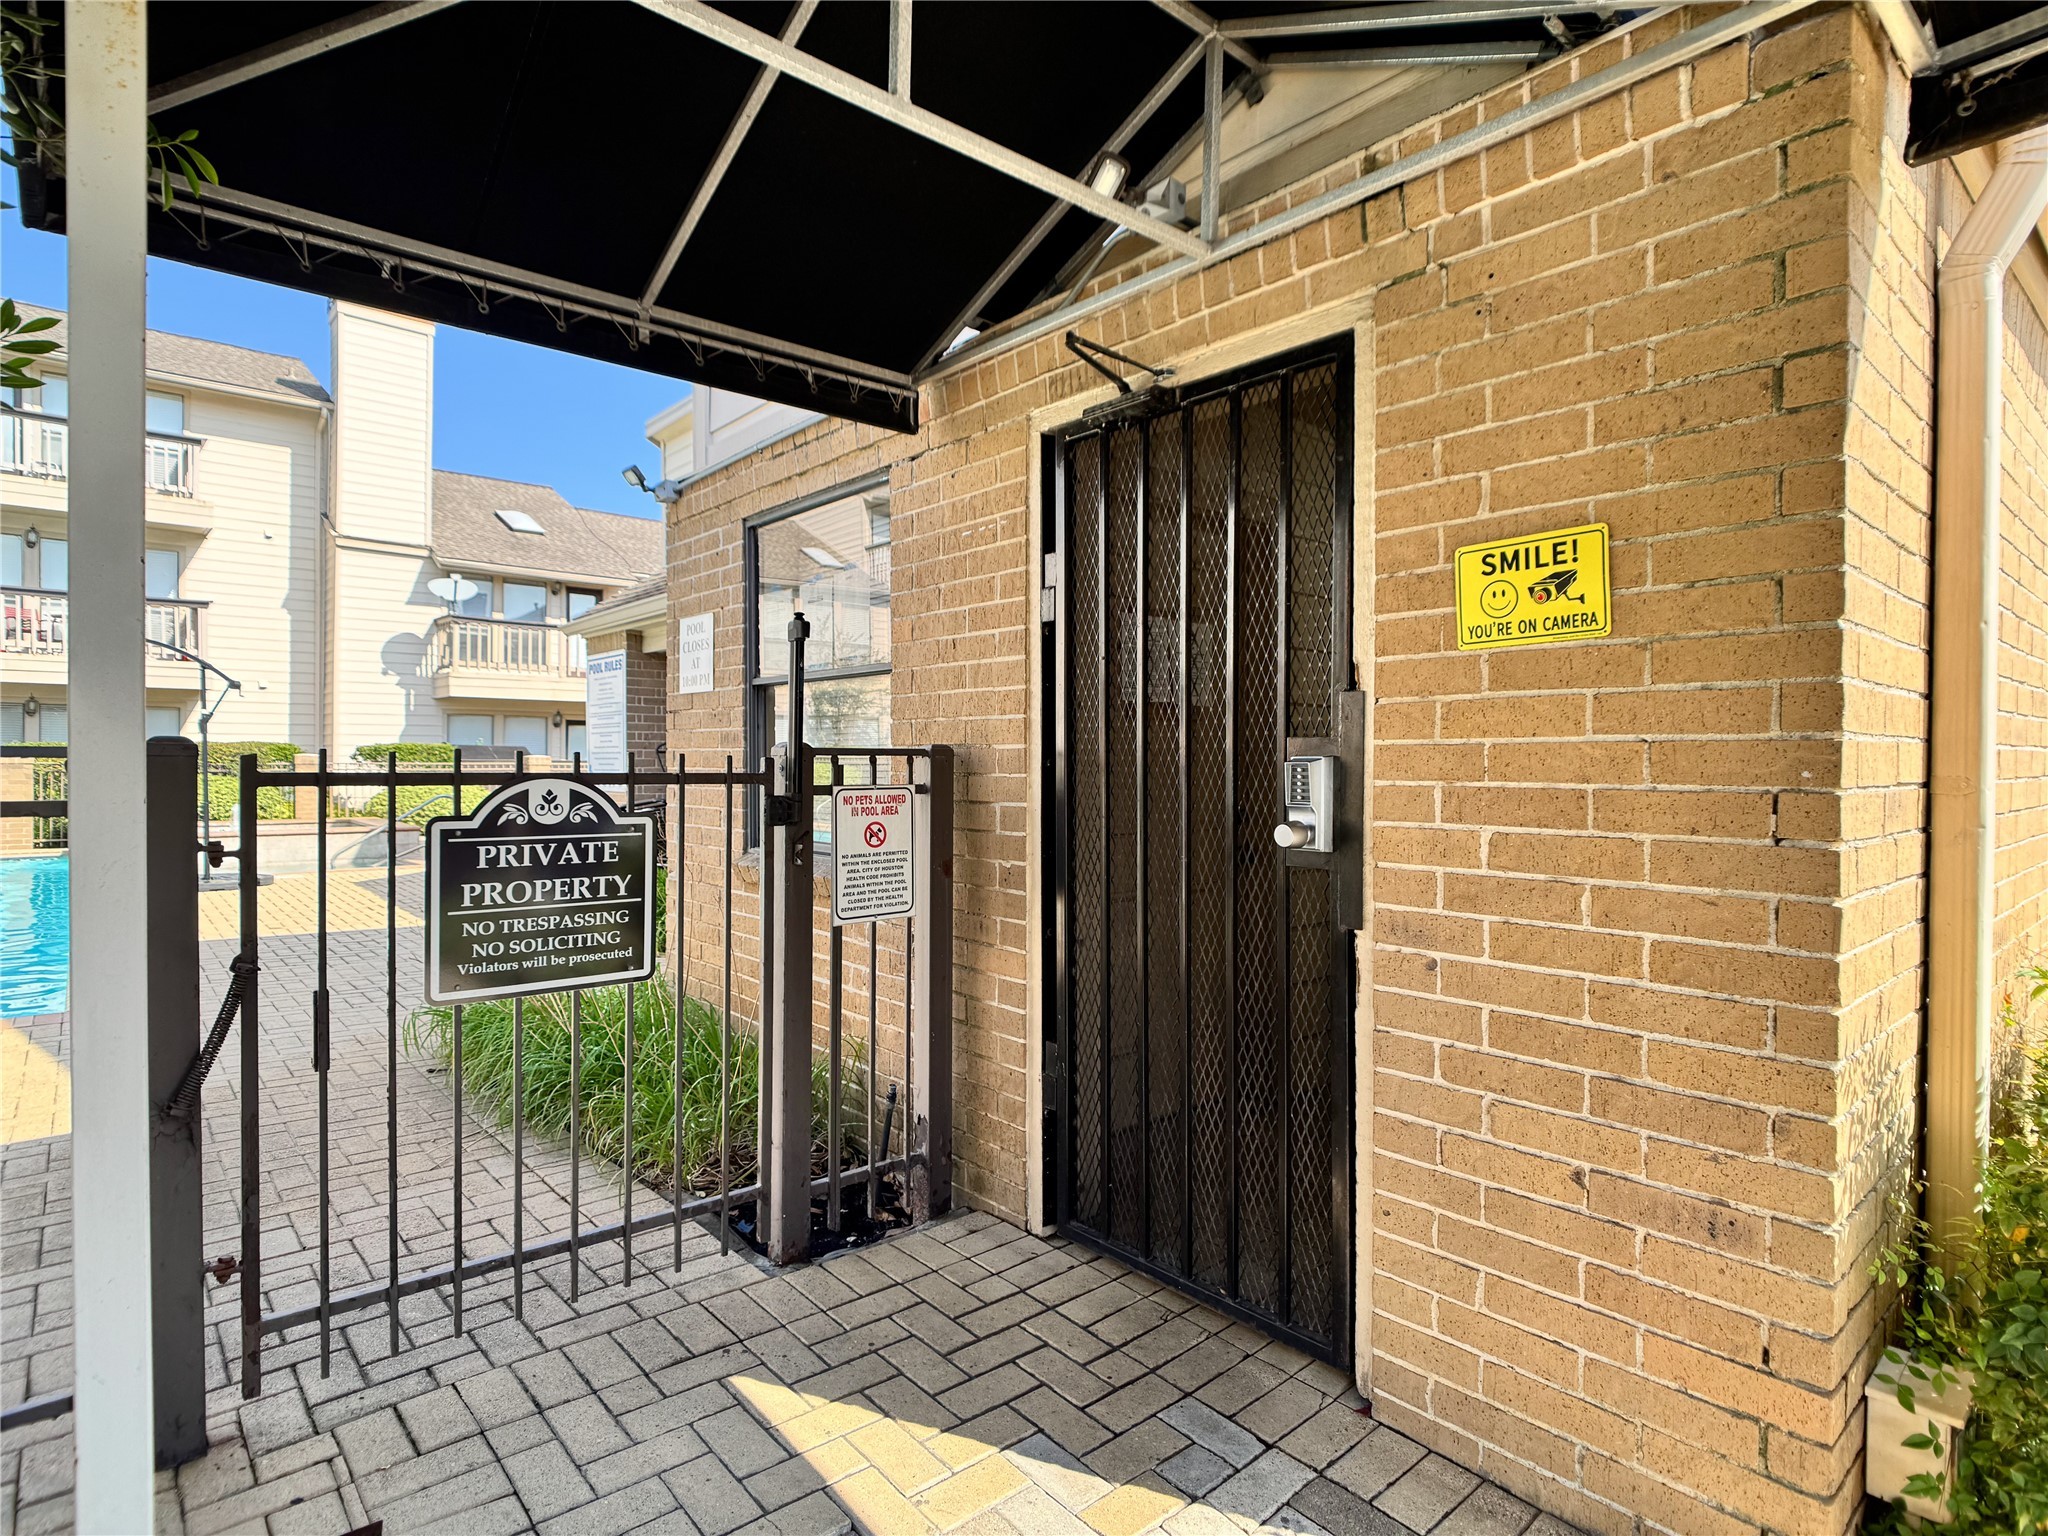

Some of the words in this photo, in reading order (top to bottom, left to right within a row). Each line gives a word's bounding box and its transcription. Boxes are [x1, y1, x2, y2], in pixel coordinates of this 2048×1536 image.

[1481, 539, 1579, 576] SMILE!
[686, 621, 705, 637] POOL
[1468, 621, 1512, 640] YOU'RE
[1518, 618, 1537, 634] ON
[1543, 611, 1599, 631] CAMERA
[682, 638, 710, 654] CLOSES
[589, 663, 604, 675] POOL
[604, 659, 623, 673] RULES
[690, 657, 701, 670] AT
[699, 673, 710, 686] PM
[843, 796, 853, 805] NO
[855, 795, 873, 805] PETS
[875, 794, 906, 804] ALLOWED
[851, 806, 859, 817] IN
[860, 806, 879, 816] POOL
[881, 805, 899, 816] AREA
[476, 841, 619, 869] PRIVATE
[461, 874, 632, 907] PROPERTY
[844, 882, 865, 890] ANIMALS
[841, 904, 872, 913] DEPARTMENT
[847, 897, 867, 905] CLOSED
[461, 921, 495, 937] NO
[499, 910, 630, 934] TRESPASSING
[471, 941, 504, 958] NO
[509, 930, 621, 954] SOLICITING
[457, 961, 518, 975] Violators
[522, 955, 547, 969] will
[551, 953, 566, 966] be
[569, 947, 633, 966] prosecuted
